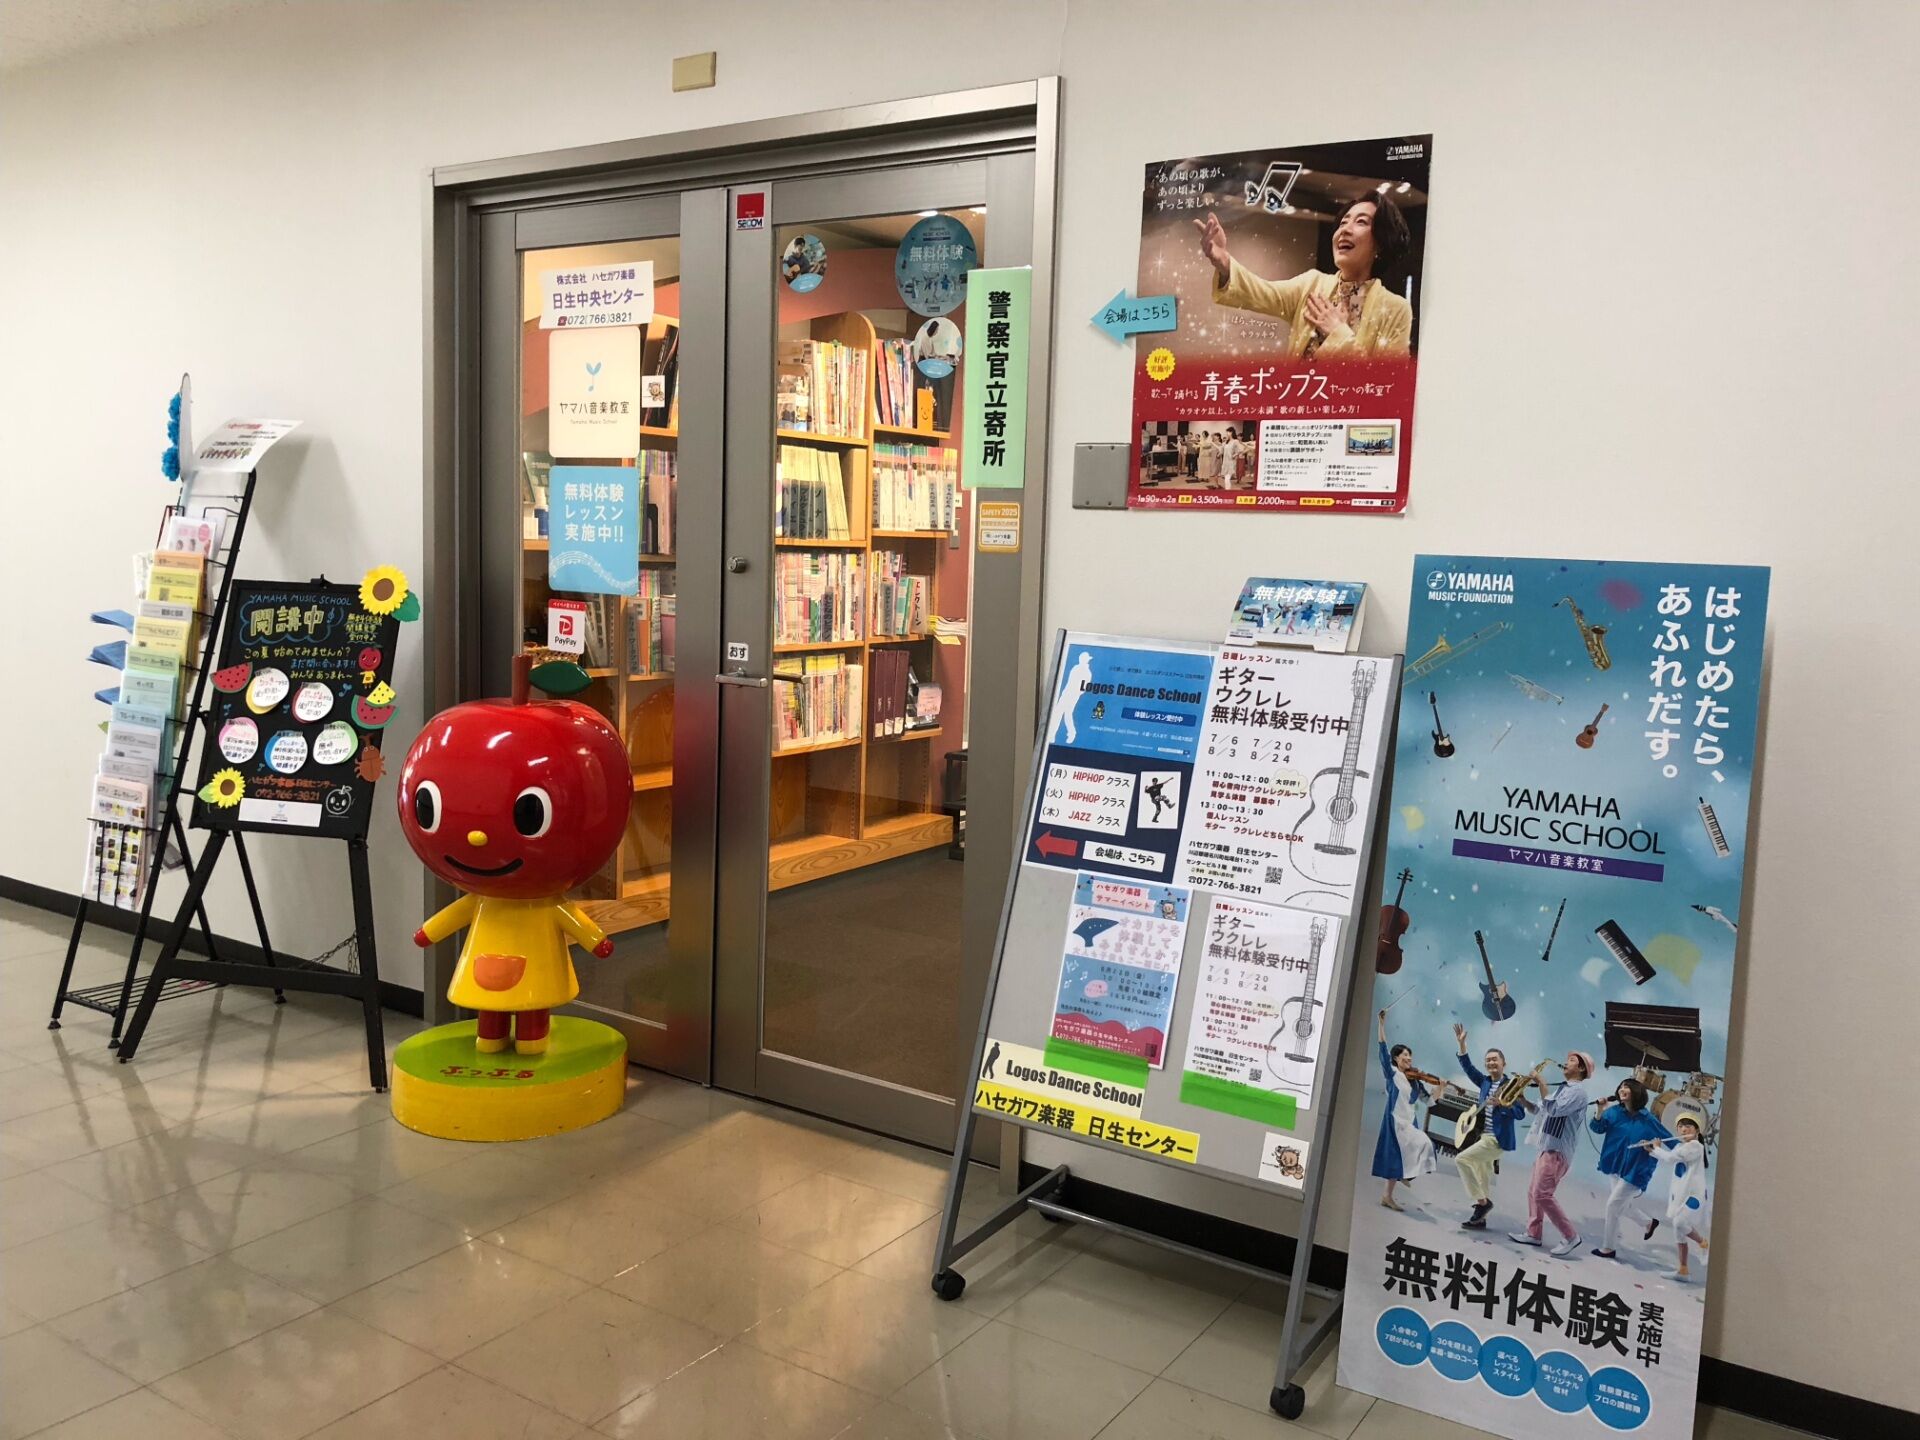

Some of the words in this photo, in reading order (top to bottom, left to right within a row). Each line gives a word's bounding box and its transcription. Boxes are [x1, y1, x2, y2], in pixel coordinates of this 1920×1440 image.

[1395, 144, 1423, 154] YAMAHA
[1158, 184, 1206, 198] あの頃より
[1157, 198, 1221, 211] ずっと楽しい。
[737, 218, 763, 229] SECOM
[909, 244, 964, 261] 無料体験
[556, 274, 588, 286] 株式会社
[591, 268, 636, 282] ハセガワ楽器
[552, 287, 645, 310] 日生中央センター
[566, 312, 632, 326] 072(766)3821
[1103, 303, 1170, 325] 会場はこちら
[1150, 364, 1171, 374] 実施中
[1153, 356, 1168, 364] 好評
[982, 290, 1012, 468] 警察官立寄所
[1199, 366, 1329, 404] 青春ポップス
[1329, 382, 1394, 398] ヤマハの教室で
[559, 402, 630, 415] ヤマハ音楽教室
[564, 483, 625, 503] 無料体験
[565, 505, 624, 521] レッスン
[564, 524, 624, 543] 実施中!!
[1448, 572, 1514, 592] YAMAHA
[291, 594, 317, 602] MUSIC
[318, 595, 352, 606] SCHOOL
[1252, 585, 1339, 605] 無料体験
[1428, 591, 1456, 602] MUSIC
[1458, 593, 1514, 604] FOUNDATION
[250, 605, 324, 636] 開講中
[554, 636, 577, 647] PayPay
[729, 646, 746, 658] おす
[1222, 652, 1273, 663] 日曜レッスン
[1218, 667, 1275, 686] ギター
[1644, 584, 1692, 779] あふれだす。
[1693, 586, 1741, 783] はじめたら、
[1080, 680, 1114, 695] Logos
[1117, 684, 1155, 698] Dance
[1157, 689, 1202, 705] School
[1216, 686, 1292, 709] ウクレレ
[1210, 704, 1350, 736] 無料体験受付中
[1211, 733, 1239, 745] 7/6
[1253, 738, 1292, 751] 7/20
[1208, 746, 1236, 758] 8/3
[1250, 751, 1290, 764] 8/24
[1050, 769, 1067, 778] (月)
[1073, 771, 1104, 783] HIPHOP
[1106, 776, 1130, 788] クラス
[1046, 788, 1063, 799] (火)
[1068, 790, 1100, 803] HIPHOP
[1102, 797, 1126, 808] クラス
[1503, 787, 1621, 820] YAMAHA
[1042, 807, 1060, 818] (木)
[1068, 811, 1092, 822] JAZZ
[1096, 816, 1120, 827] クラス
[1205, 822, 1226, 831] ギター
[1455, 809, 1540, 840] MUSIC
[1549, 820, 1666, 854] SCHOOL
[1095, 847, 1155, 866] 会場は、こちら
[1189, 840, 1230, 853] ハセガワ楽器
[1236, 847, 1279, 859] 日生センター
[1509, 848, 1604, 872] ヤマハ音楽教室
[1097, 884, 1141, 896] ハセガワ楽器
[1196, 877, 1262, 895] 072-766-3821
[1096, 894, 1150, 909] サマーイベント
[1216, 903, 1254, 914] 日曜レッスン
[1213, 914, 1255, 930] ギター
[1212, 929, 1267, 949] ウクレレ
[1208, 943, 1309, 973] 無料体験受付中
[1006, 1060, 1045, 1084] Logos
[1048, 1072, 1090, 1095] Dance
[1092, 1082, 1142, 1108] School
[974, 1089, 1075, 1130] ハセガワ楽器
[1088, 1117, 1194, 1156] 日生センター
[1382, 1236, 1634, 1357] 無料体験
[1636, 1301, 1665, 1368] 実施中
[1493, 1368, 1521, 1382] スタイル
[1494, 1359, 1521, 1372] レッスン
[1543, 1375, 1580, 1390] オリジナル
